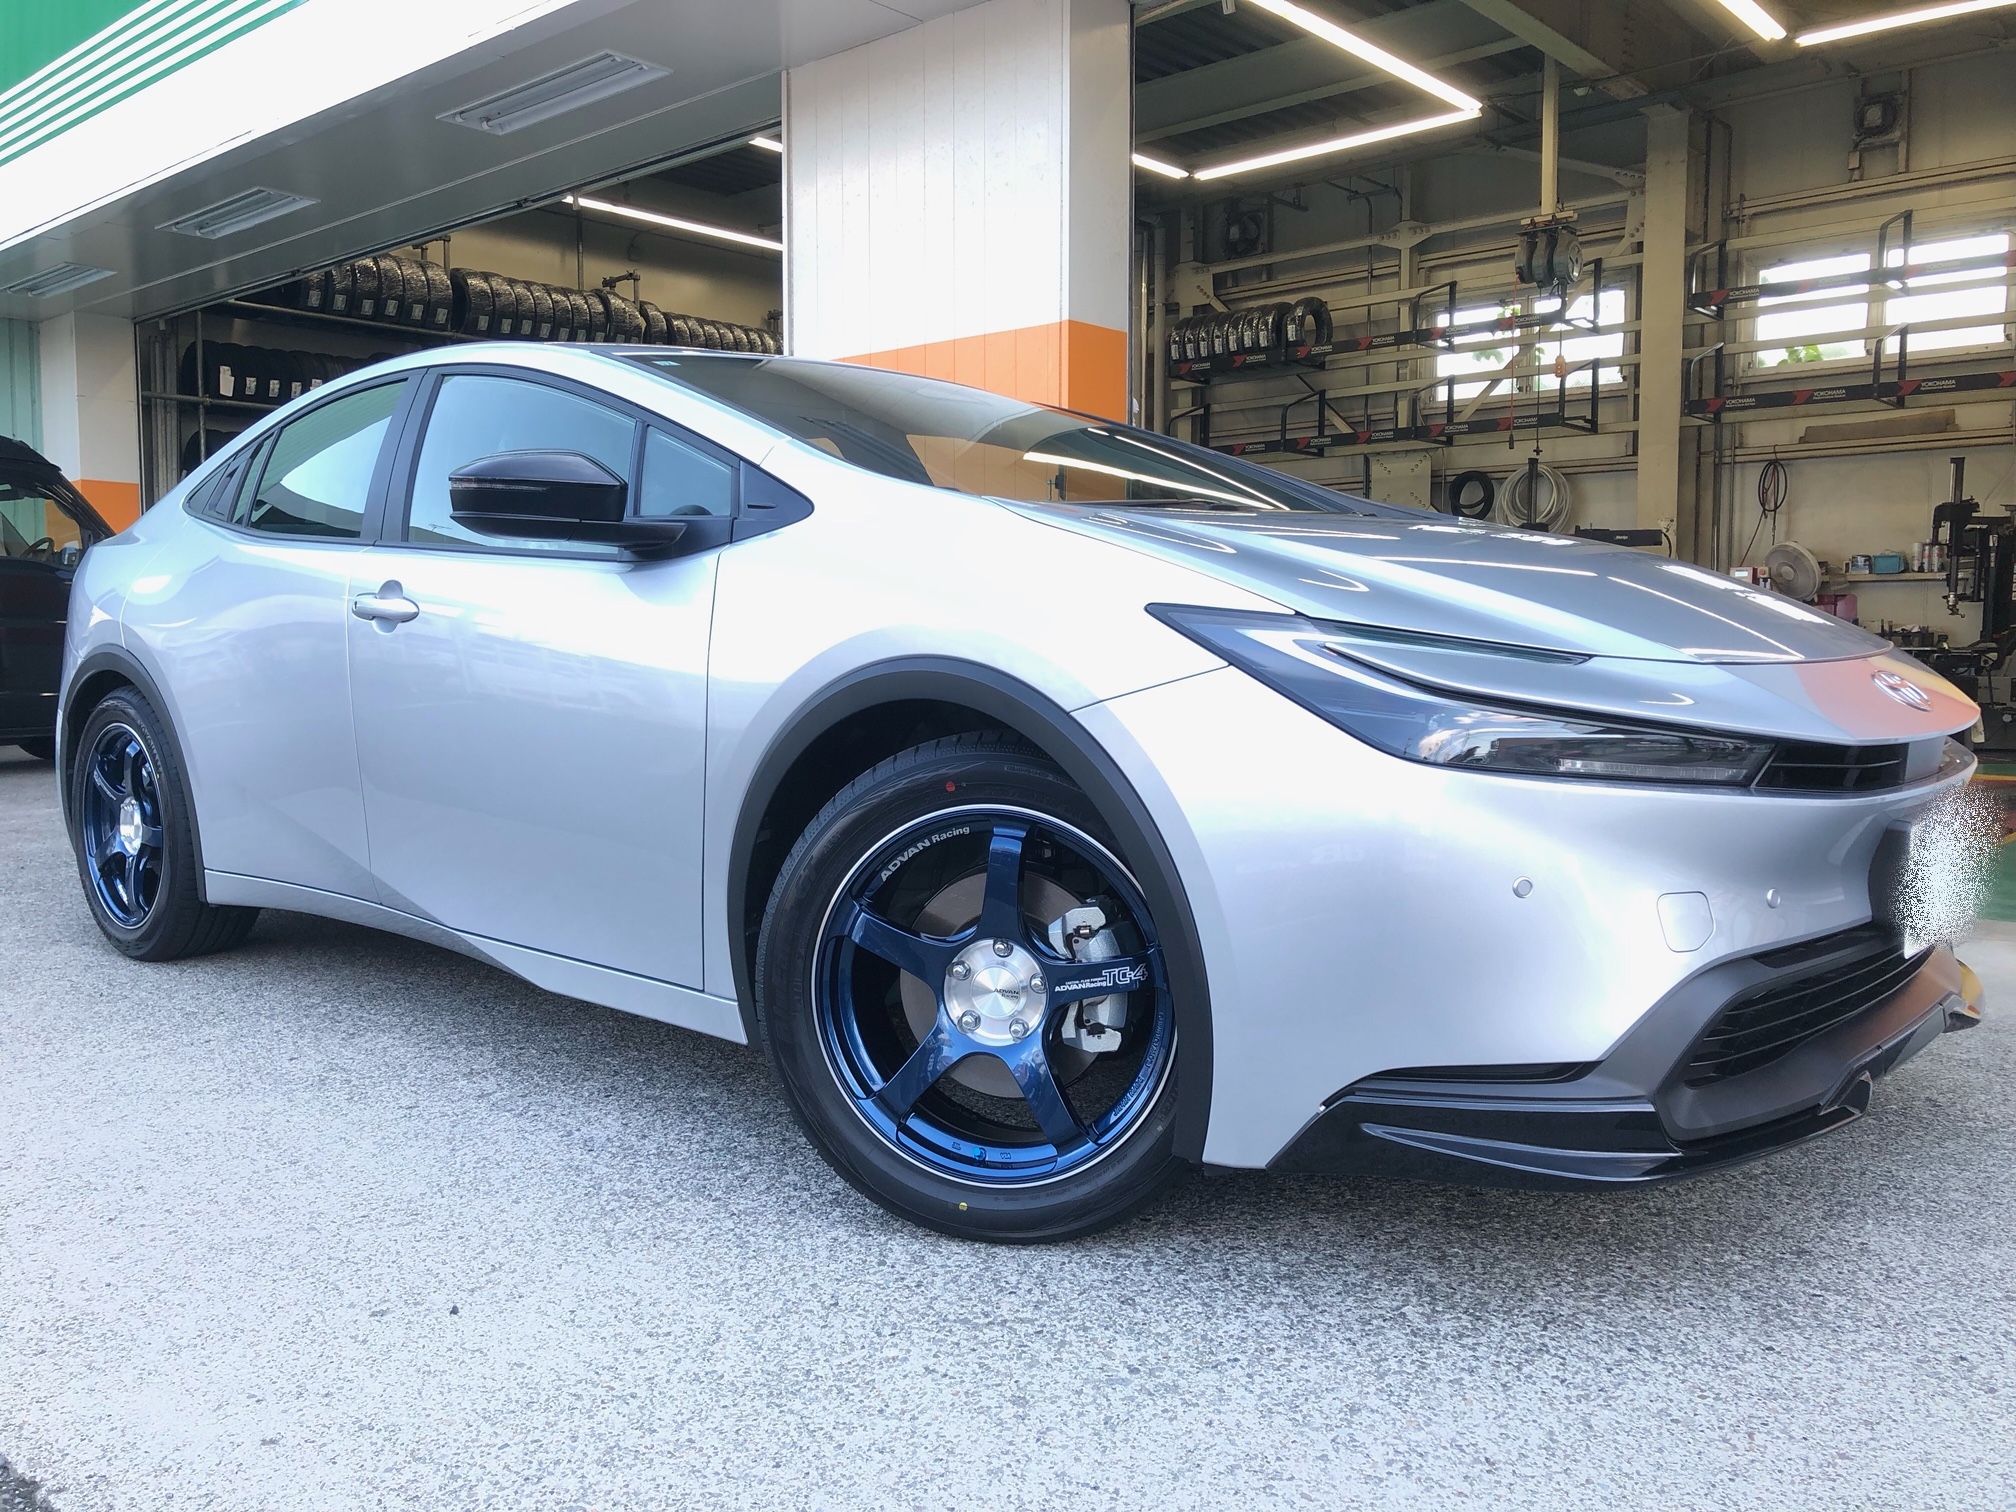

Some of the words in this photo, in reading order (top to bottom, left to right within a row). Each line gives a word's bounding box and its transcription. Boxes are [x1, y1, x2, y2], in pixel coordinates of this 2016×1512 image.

[1729, 287, 1760, 297] YOKOHAMA
[1372, 335, 1395, 343] YOKOHAMA
[1920, 379, 1956, 388] YOKOHAMA
[1813, 389, 1846, 397] YOKOHAMA
[1725, 397, 1756, 405] YOKOHAMA
[881, 839, 931, 881] ADVAN
[931, 826, 970, 843] Racing
[1102, 963, 1149, 987] TC-4
